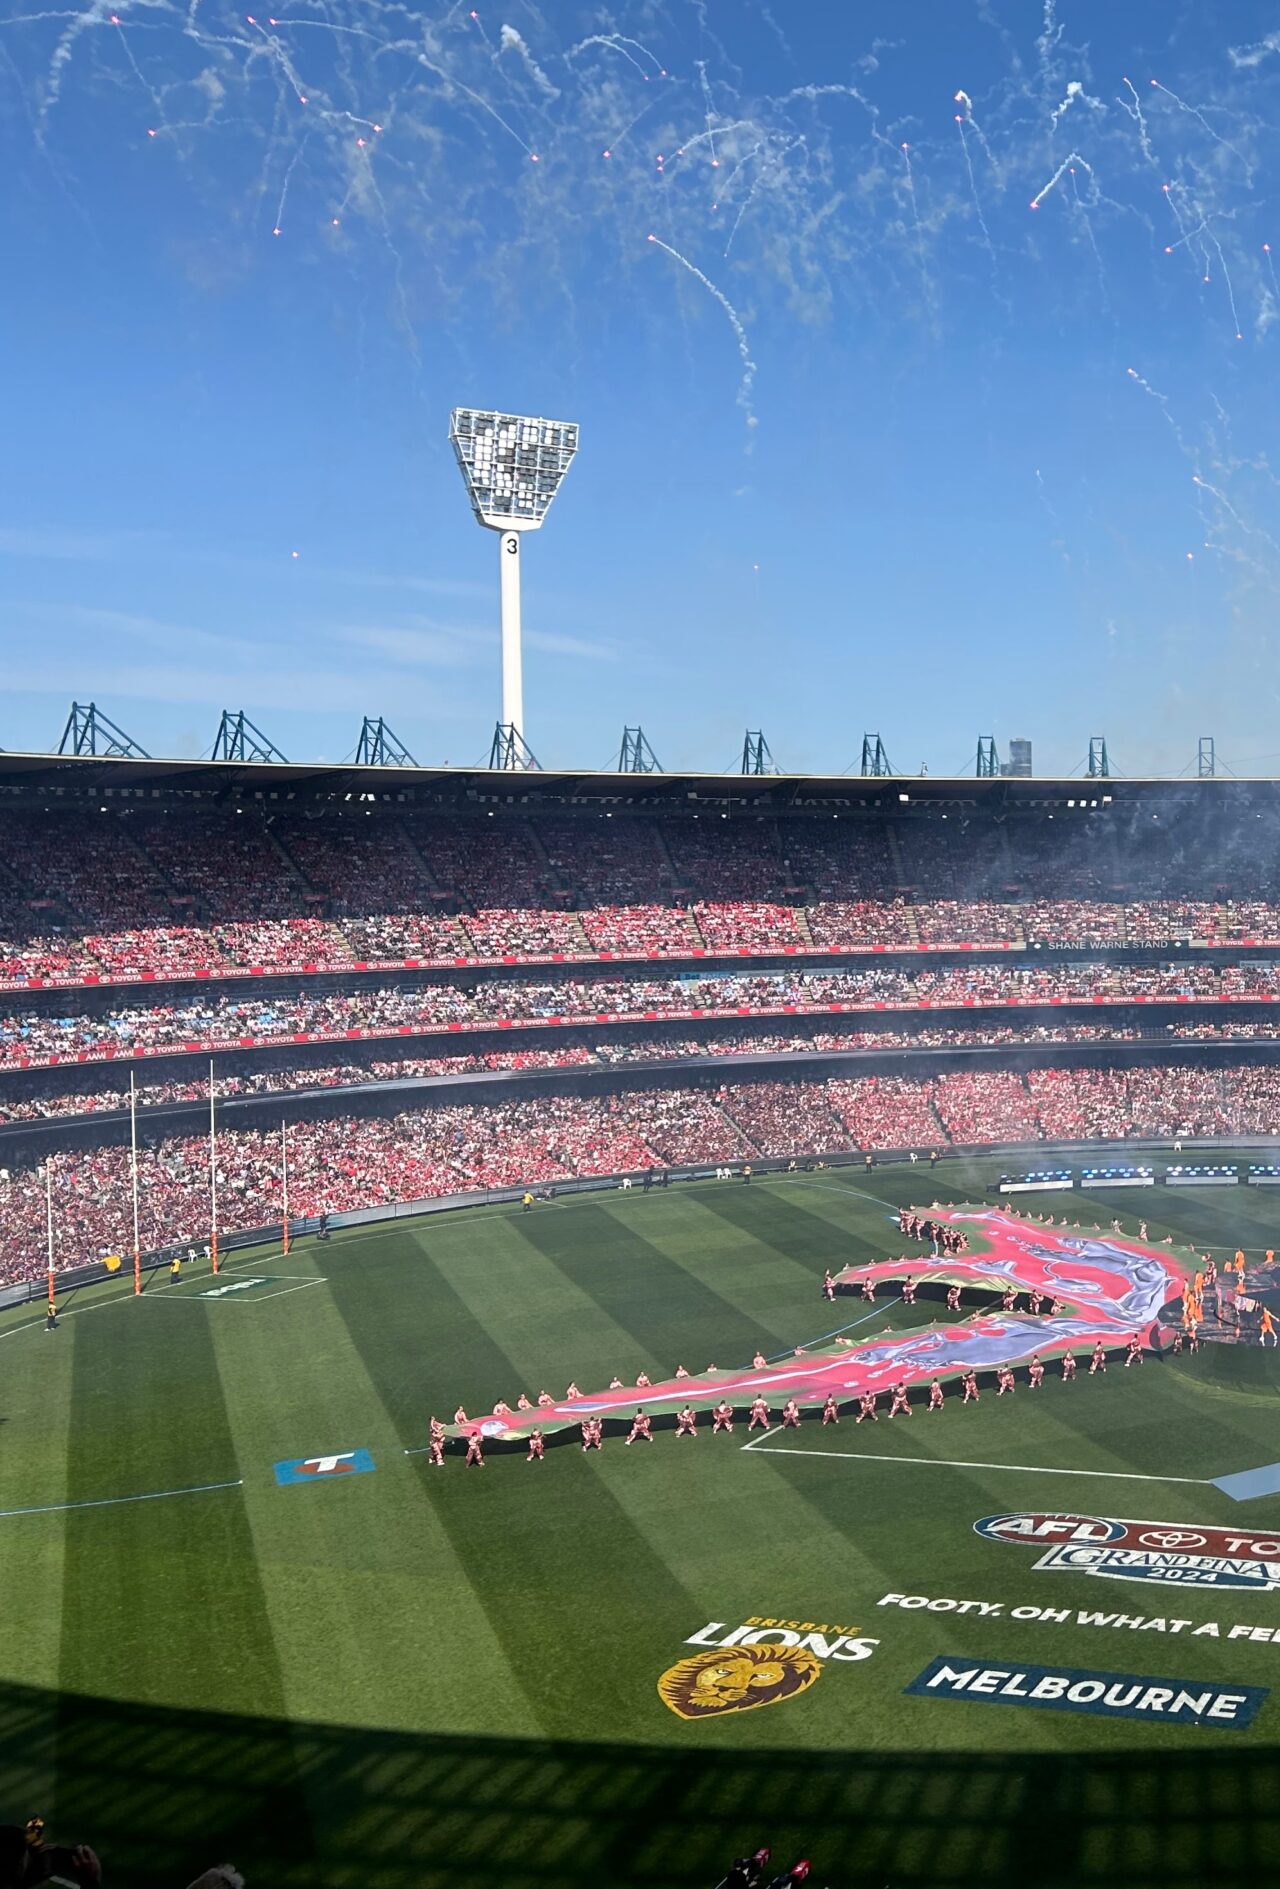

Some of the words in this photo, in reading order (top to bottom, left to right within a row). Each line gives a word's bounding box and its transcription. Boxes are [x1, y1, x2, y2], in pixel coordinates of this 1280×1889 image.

[507, 538, 517, 555] 3
[1048, 942, 1086, 950] SHANE
[1090, 941, 1129, 949] WARNE
[1132, 940, 1168, 949] STAND
[111, 974, 142, 982] TOYOTA
[167, 971, 196, 979] TOYOTA
[54, 977, 84, 985] TOYOTA
[372, 1028, 399, 1036] TOYOTA
[422, 1024, 449, 1032] TOYOTA
[266, 1035, 294, 1044] TOYOTA
[319, 1031, 346, 1040] TOYOTA
[156, 1044, 186, 1053] TOYOTA
[213, 1040, 240, 1048] TOYOTA
[983, 1518, 1113, 1541] AFL
[1060, 1548, 1190, 1566] GRAND
[1146, 1567, 1218, 1582] 2024
[876, 1593, 1005, 1617] FOOTY.
[1010, 1606, 1072, 1623] OH
[1076, 1611, 1192, 1633] WHAT
[1190, 1622, 1221, 1637] A
[744, 1616, 864, 1636] BRISBANE
[682, 1622, 881, 1661] LIONS
[926, 1664, 1247, 1719] MELBOURNE
